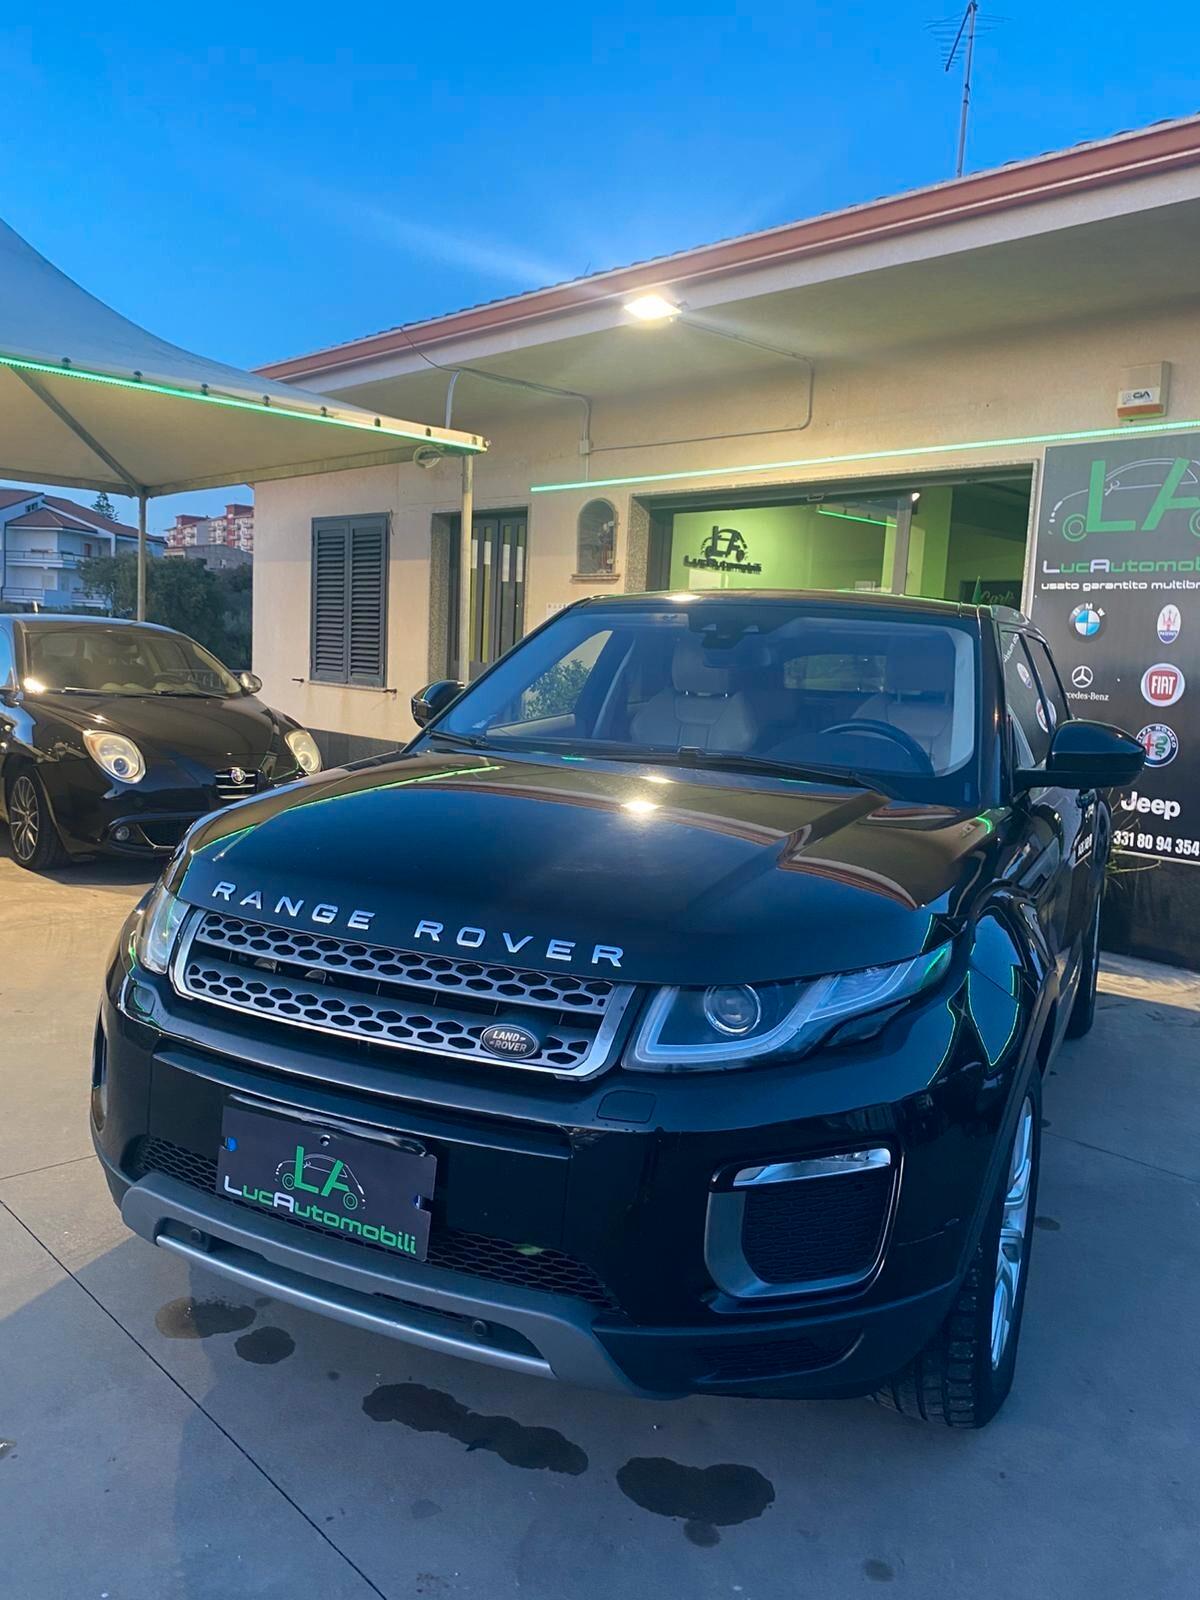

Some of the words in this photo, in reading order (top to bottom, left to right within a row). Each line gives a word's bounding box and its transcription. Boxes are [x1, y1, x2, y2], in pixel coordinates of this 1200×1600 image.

[1041, 581, 1080, 590] usato
[1082, 579, 1148, 592] garantito
[1151, 675, 1176, 695] FIAT
[1120, 791, 1181, 820] Jeep
[1137, 833, 1153, 850] 80
[1156, 836, 1172, 852] 94
[1175, 838, 1200, 856] 354
[211, 880, 376, 931] RANGE
[413, 919, 625, 968] ROVER
[492, 1030, 520, 1042] LAND
[495, 1039, 528, 1052] ROVER
[224, 1175, 416, 1255] LucAutomobili
